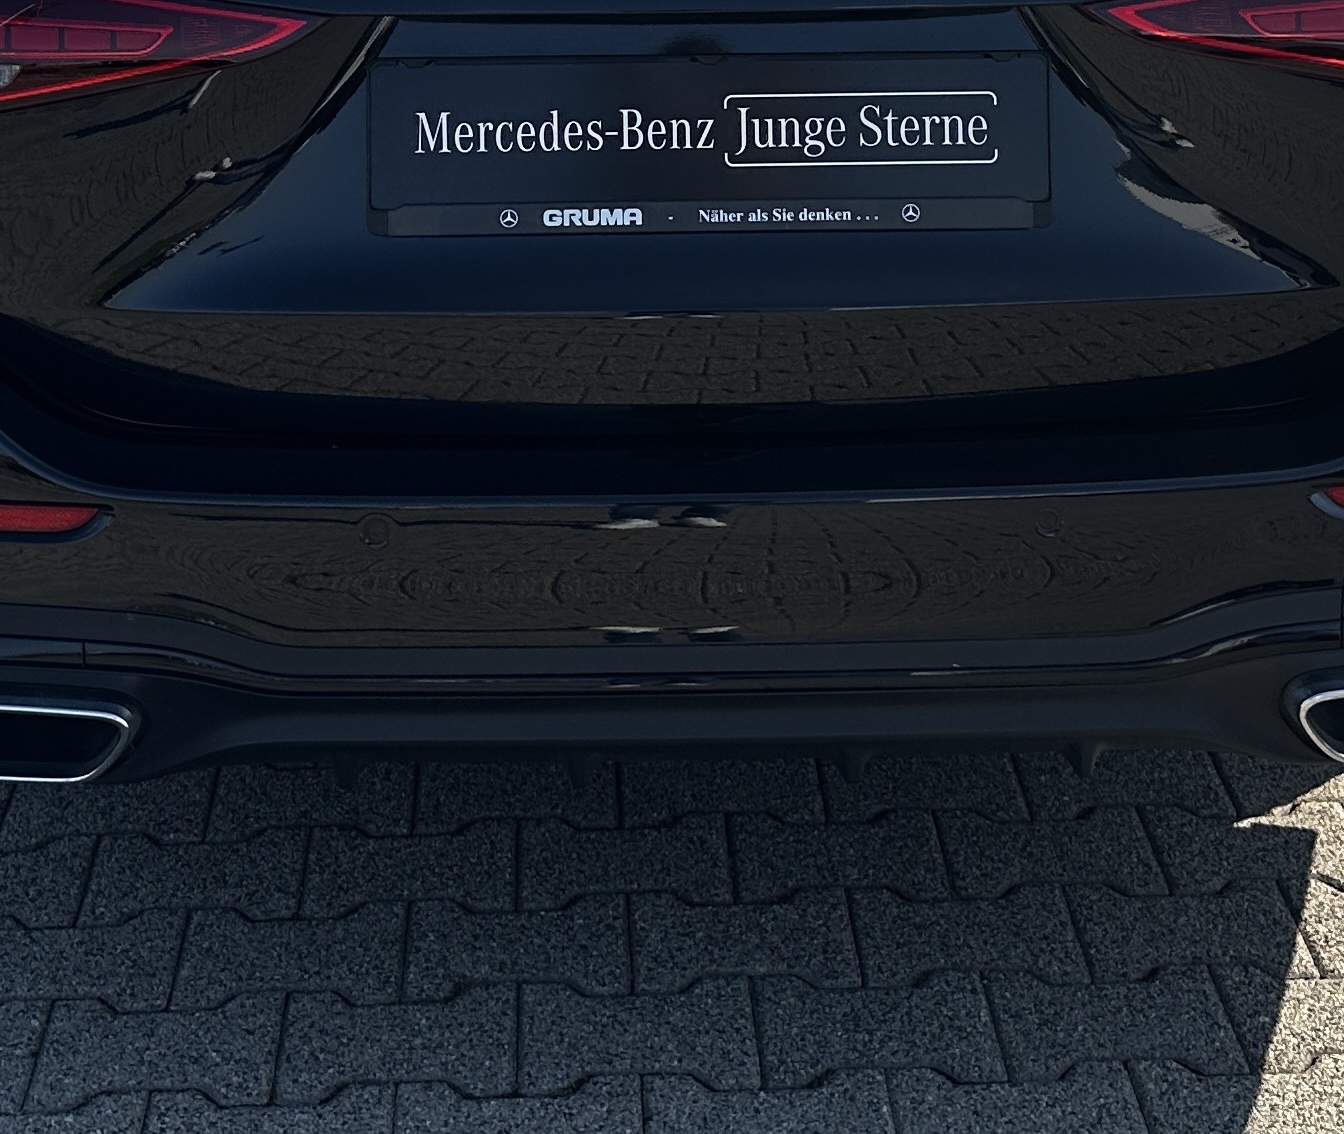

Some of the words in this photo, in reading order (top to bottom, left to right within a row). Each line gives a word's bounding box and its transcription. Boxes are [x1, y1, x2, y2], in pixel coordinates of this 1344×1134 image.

[414, 109, 715, 154] Mercedes-Benz
[734, 106, 846, 158] Junge
[859, 104, 988, 148] Sterne
[542, 207, 643, 227] GRUMA
[698, 208, 744, 223] Näher
[747, 208, 769, 222] als
[772, 207, 795, 222] Sie
[798, 207, 852, 222] denken
